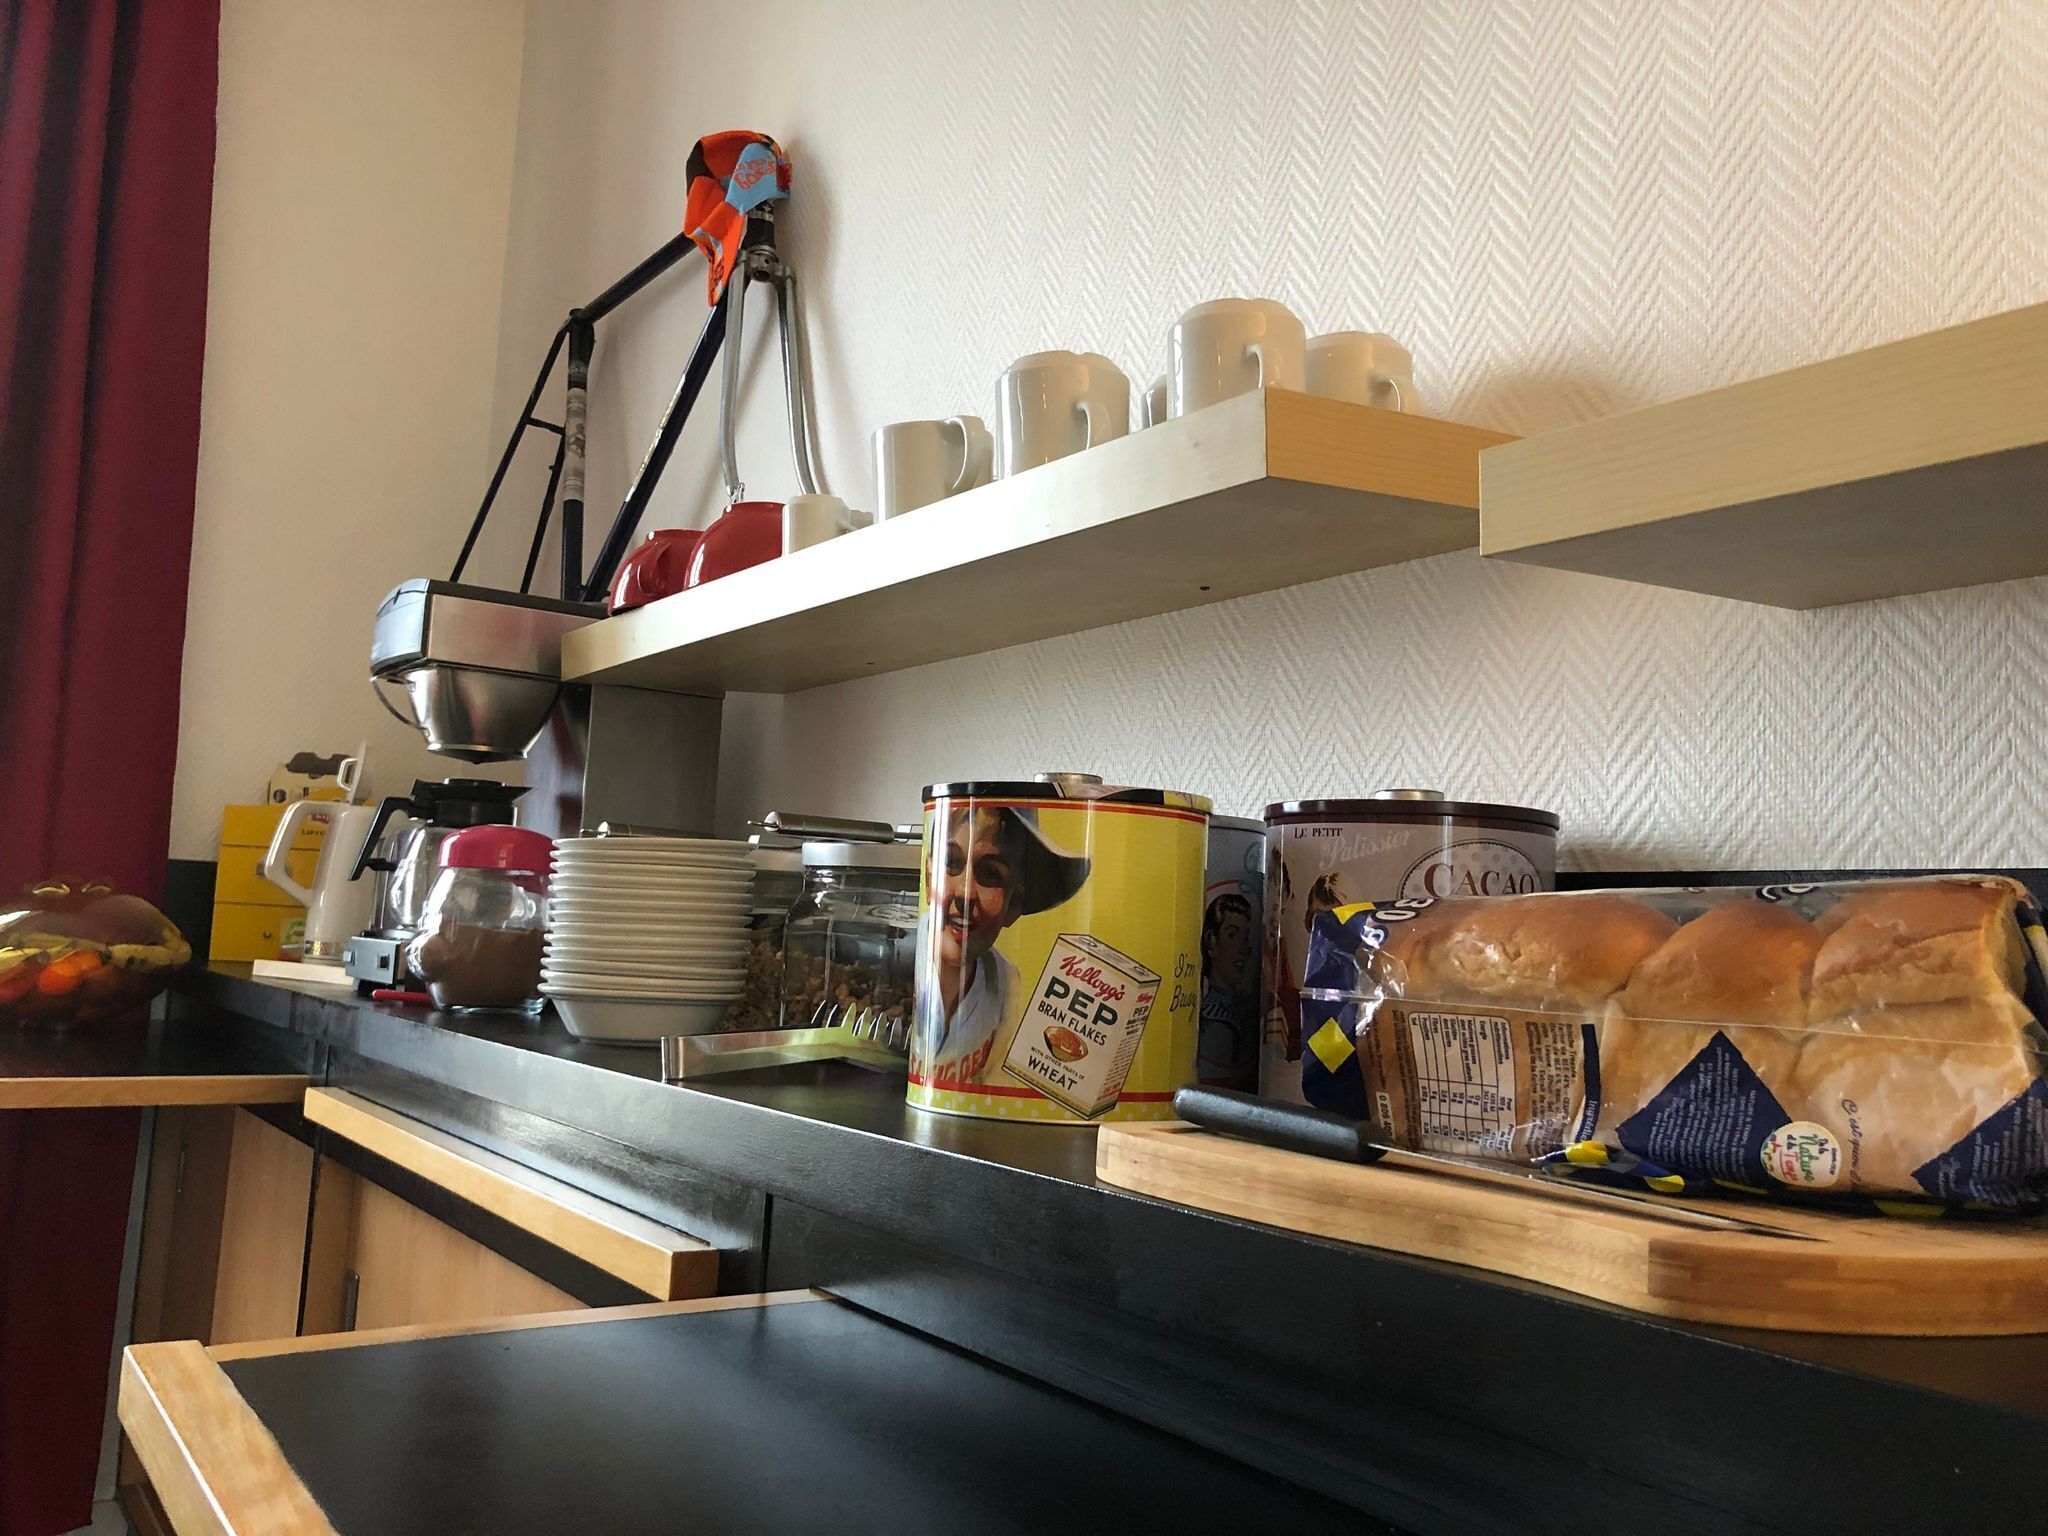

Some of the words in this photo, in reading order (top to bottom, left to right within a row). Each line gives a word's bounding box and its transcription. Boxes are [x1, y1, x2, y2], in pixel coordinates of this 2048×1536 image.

[1294, 827, 1308, 839] LE
[1312, 827, 1343, 838] PETIT
[1423, 862, 1535, 898] CACAO
[1060, 955, 1126, 1001] Kellogg's
[1174, 953, 1195, 978] I'm
[1044, 976, 1119, 1026] PEP
[1132, 1005, 1149, 1018] PEP
[1038, 1000, 1067, 1023] BRAN
[1068, 1017, 1107, 1046] FLAKES
[1027, 1055, 1078, 1091] WHEAT
[1031, 1046, 1043, 1057] WITH
[1044, 1054, 1061, 1067] OTHER
[1799, 1134, 1820, 1182] Nature
